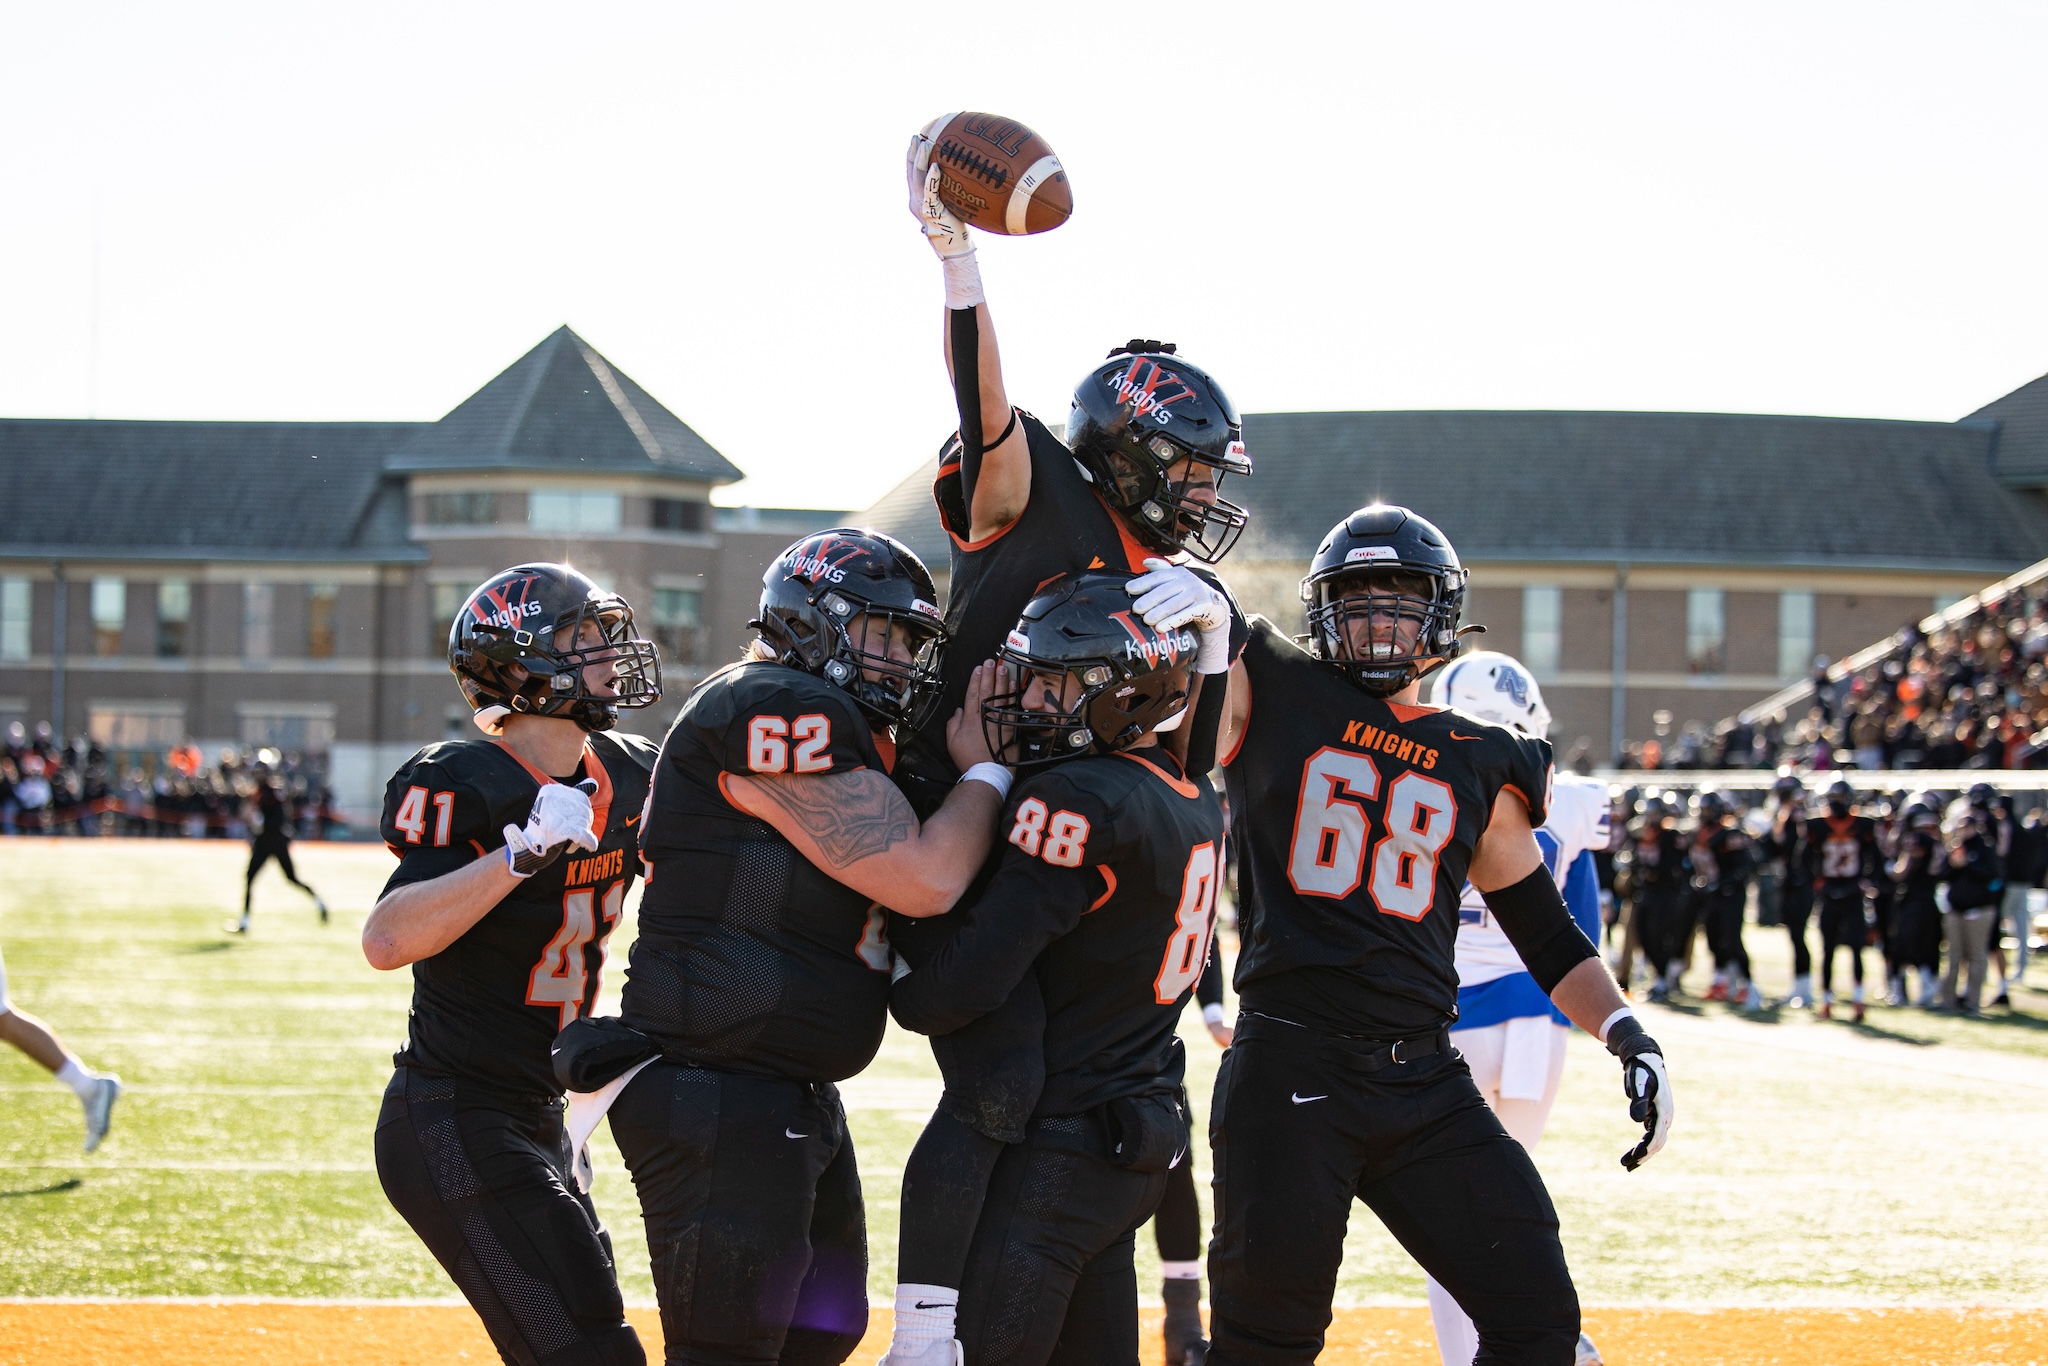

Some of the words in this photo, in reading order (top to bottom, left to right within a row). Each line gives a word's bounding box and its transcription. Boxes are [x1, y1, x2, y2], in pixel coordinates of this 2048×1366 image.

[1107, 370, 1173, 425] Knights
[784, 549, 848, 584] Knights
[1124, 632, 1191, 662] Knights
[747, 713, 835, 774] 62
[1341, 719, 1440, 770] KNIGHTS
[395, 785, 456, 847] 41
[1008, 796, 1092, 869] 88
[1286, 745, 1459, 923] 68
[564, 848, 625, 887] KNIGHTS
